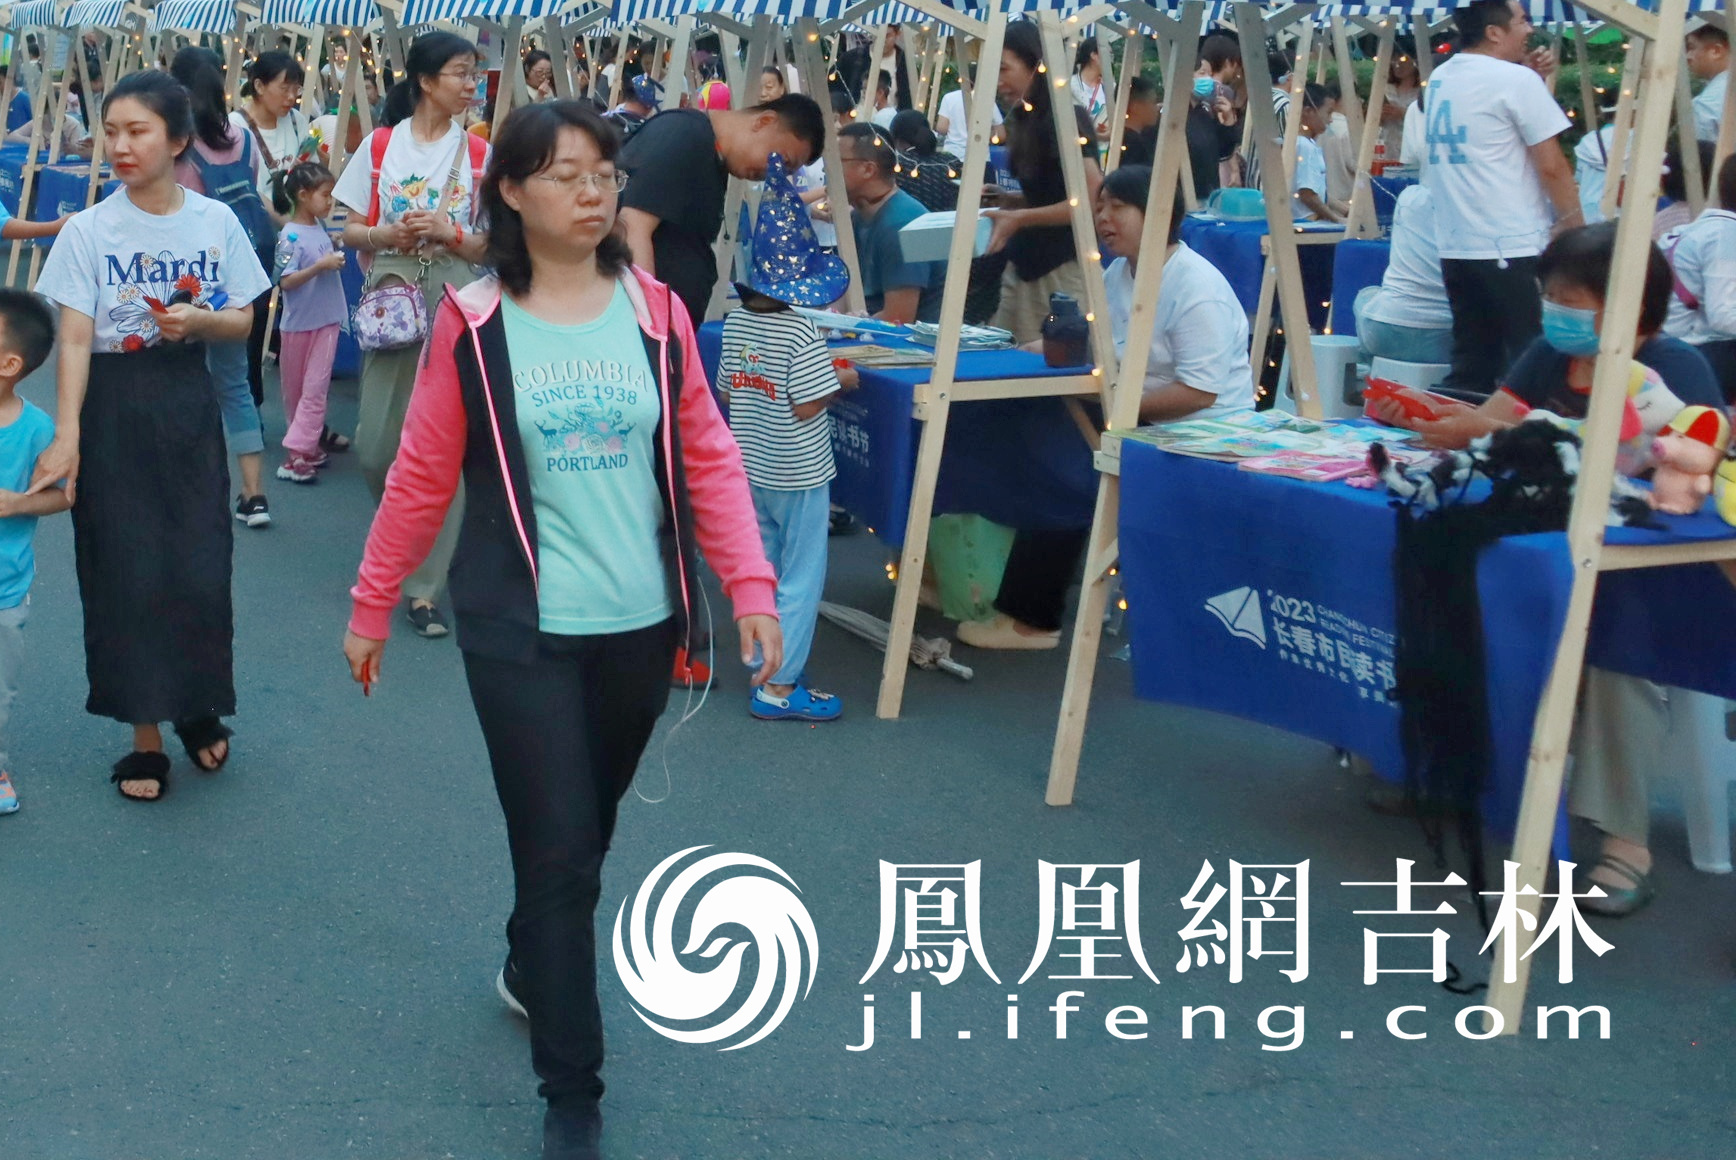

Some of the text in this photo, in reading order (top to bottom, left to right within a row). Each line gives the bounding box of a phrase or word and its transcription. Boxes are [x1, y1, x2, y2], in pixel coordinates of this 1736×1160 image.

[105, 250, 220, 286] Mardi
[513, 359, 649, 393] COLUMBIA
[531, 385, 638, 407] SINCE 1938
[547, 453, 629, 473] PORTLAND
[1273, 616, 1397, 690] 长春市民读书
